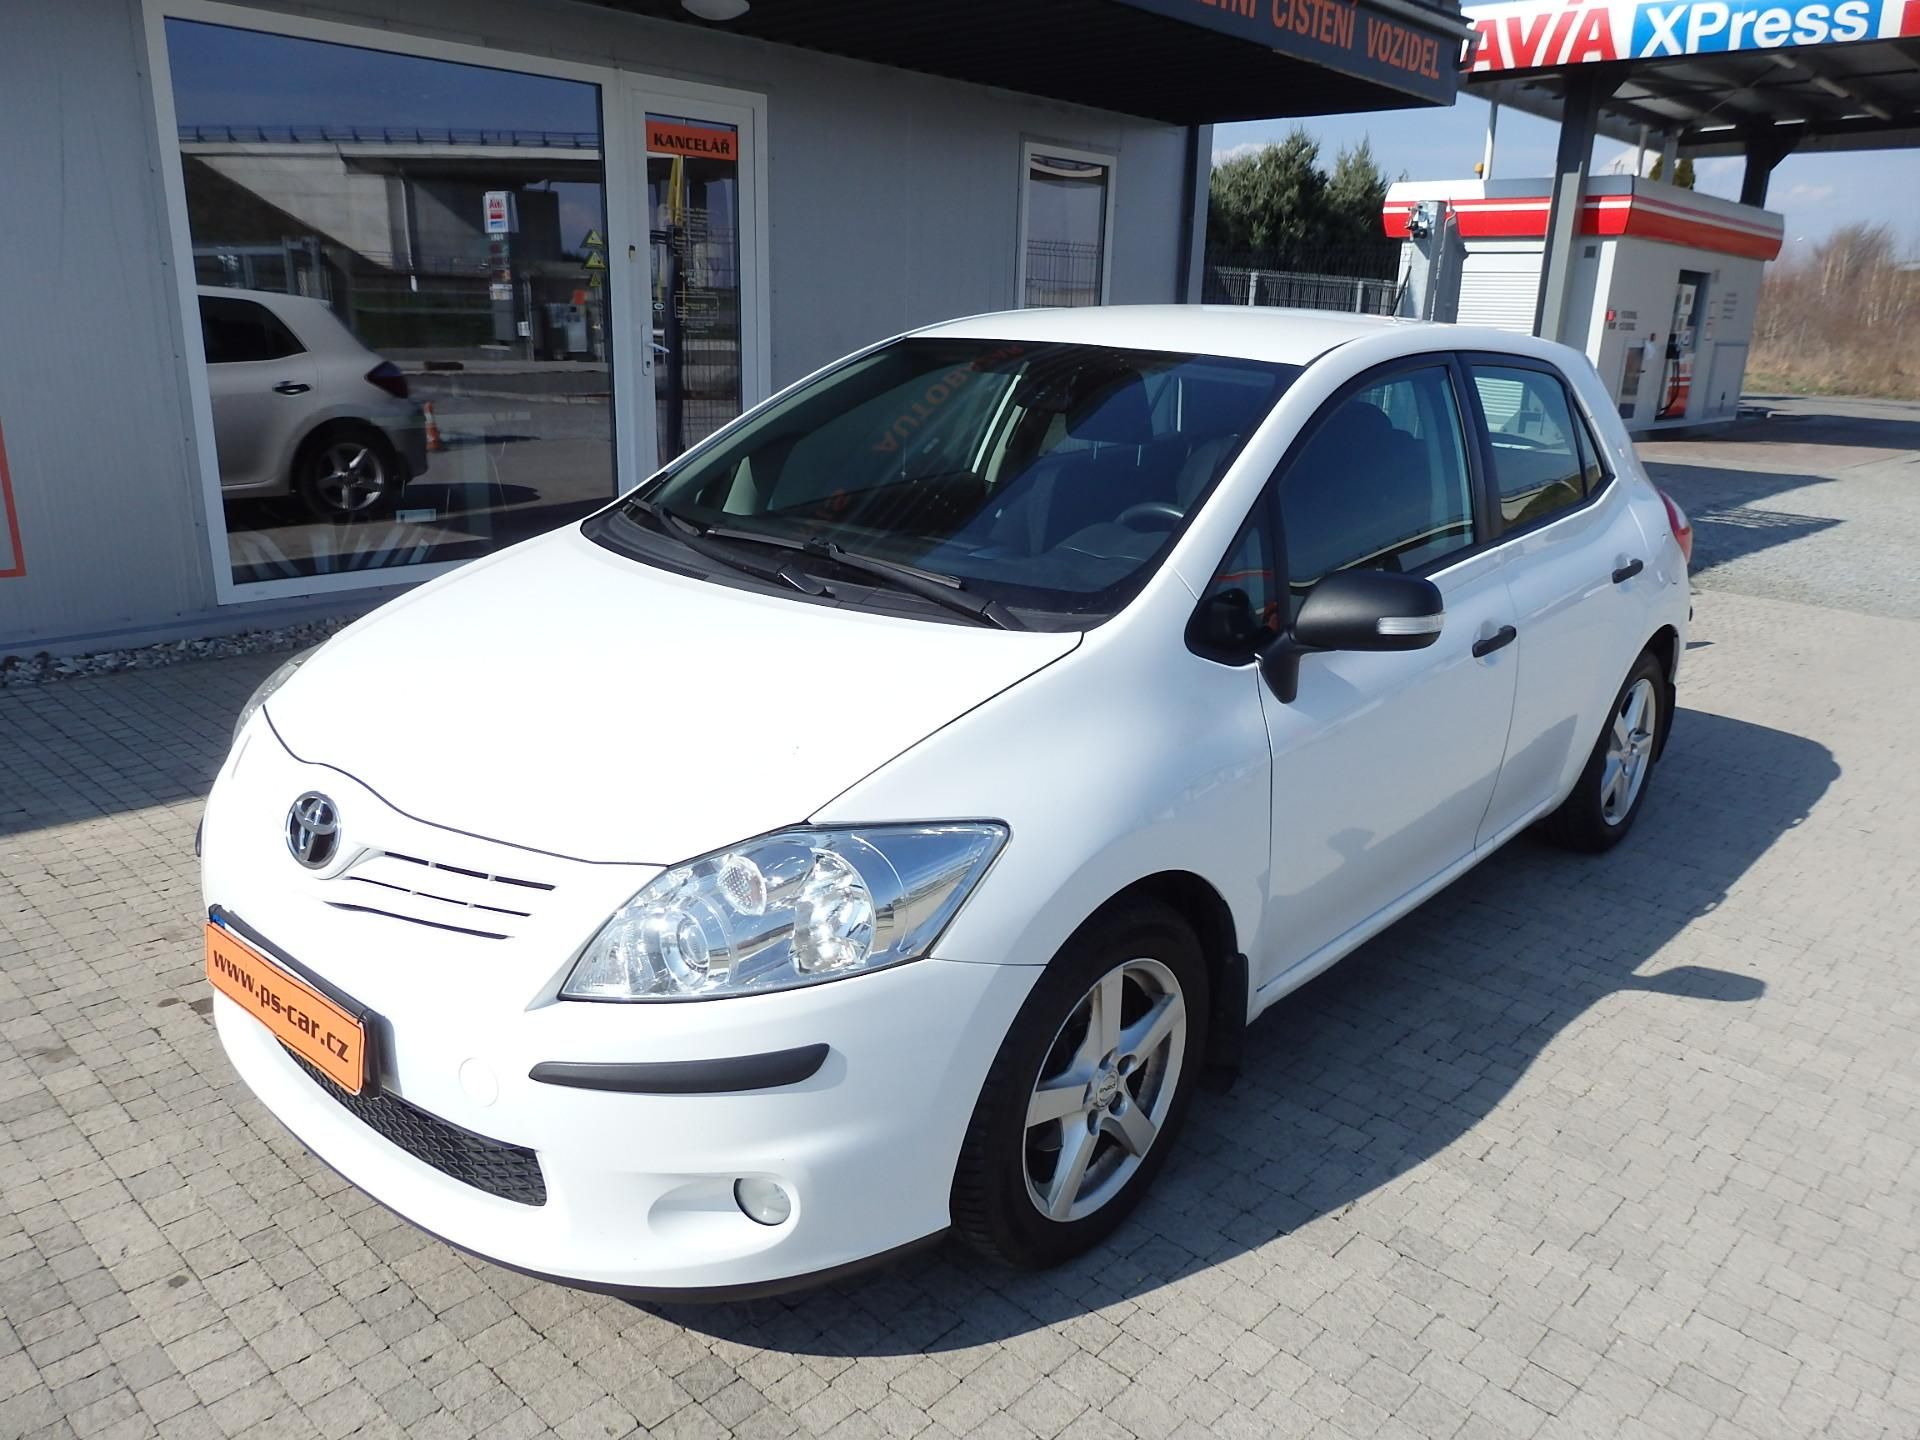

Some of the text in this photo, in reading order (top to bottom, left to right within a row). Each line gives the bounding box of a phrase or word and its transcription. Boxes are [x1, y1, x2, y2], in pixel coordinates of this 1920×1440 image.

[1367, 16, 1441, 80] VOZIDEL
[1638, 1, 1870, 58] XPress
[653, 132, 730, 155] KANCELÁŘ
[213, 950, 350, 1064] www.ps-car.cz
